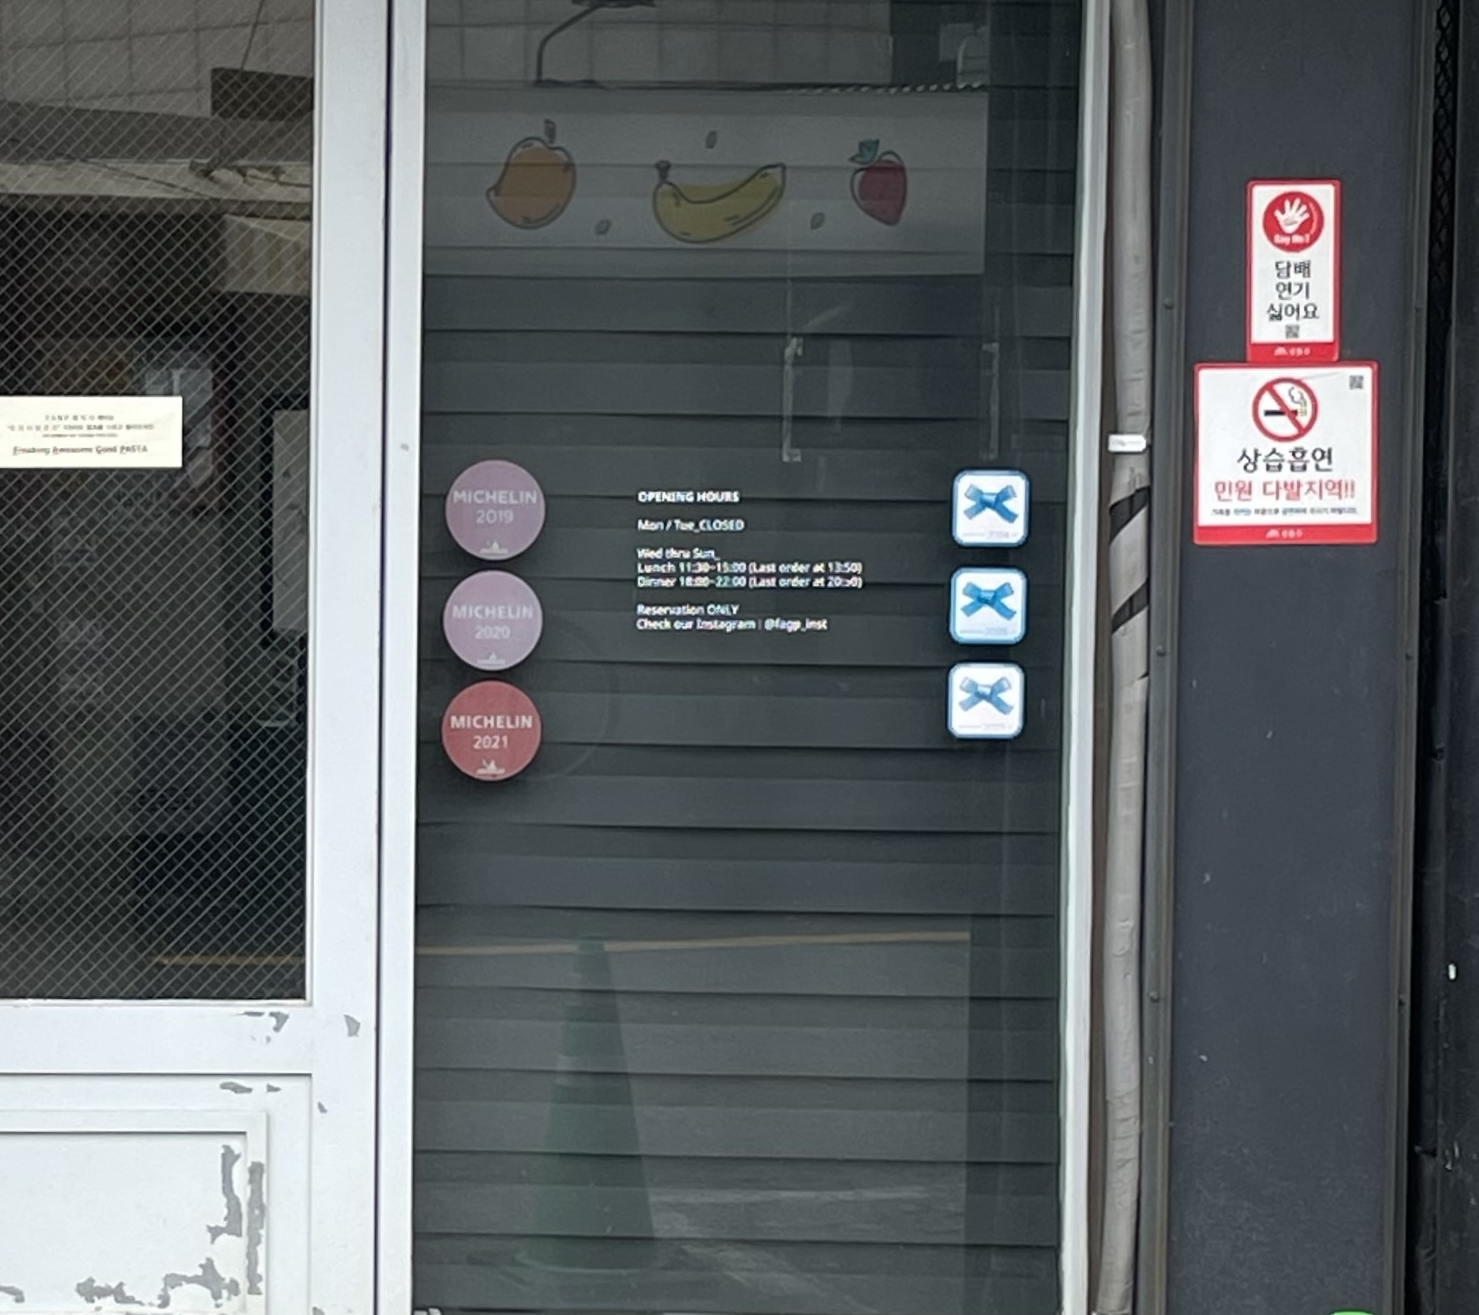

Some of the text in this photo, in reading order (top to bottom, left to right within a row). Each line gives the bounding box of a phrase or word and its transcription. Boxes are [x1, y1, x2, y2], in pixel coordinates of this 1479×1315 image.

[1274, 259, 1312, 280] 담배
[1275, 281, 1310, 301] 연기
[1267, 302, 1320, 322] 싫어요
[1236, 446, 1335, 475] 상습흡연
[453, 489, 538, 505] MICHELIN
[637, 490, 741, 503] OPENING HOURS
[1214, 479, 1356, 503] 민원 다발지역!!
[476, 509, 514, 524] 2019
[637, 519, 664, 531] Mon
[636, 547, 663, 559] Wed
[665, 547, 691, 559] thru
[637, 561, 676, 574] Lunch
[748, 561, 777, 575] (Last
[778, 561, 811, 574] order
[812, 562, 825, 574] at
[637, 575, 677, 588] Dinner
[748, 575, 777, 589] (Last
[778, 575, 811, 588] order
[812, 576, 825, 588] at
[452, 604, 534, 620] MICHELIN
[636, 603, 740, 616] Reservation ONLY
[474, 625, 511, 640] 2020
[636, 618, 671, 630] Check
[673, 620, 694, 630] our
[696, 618, 756, 633] Instagram
[450, 714, 534, 730] MICHELIN
[472, 735, 510, 750] 2021
